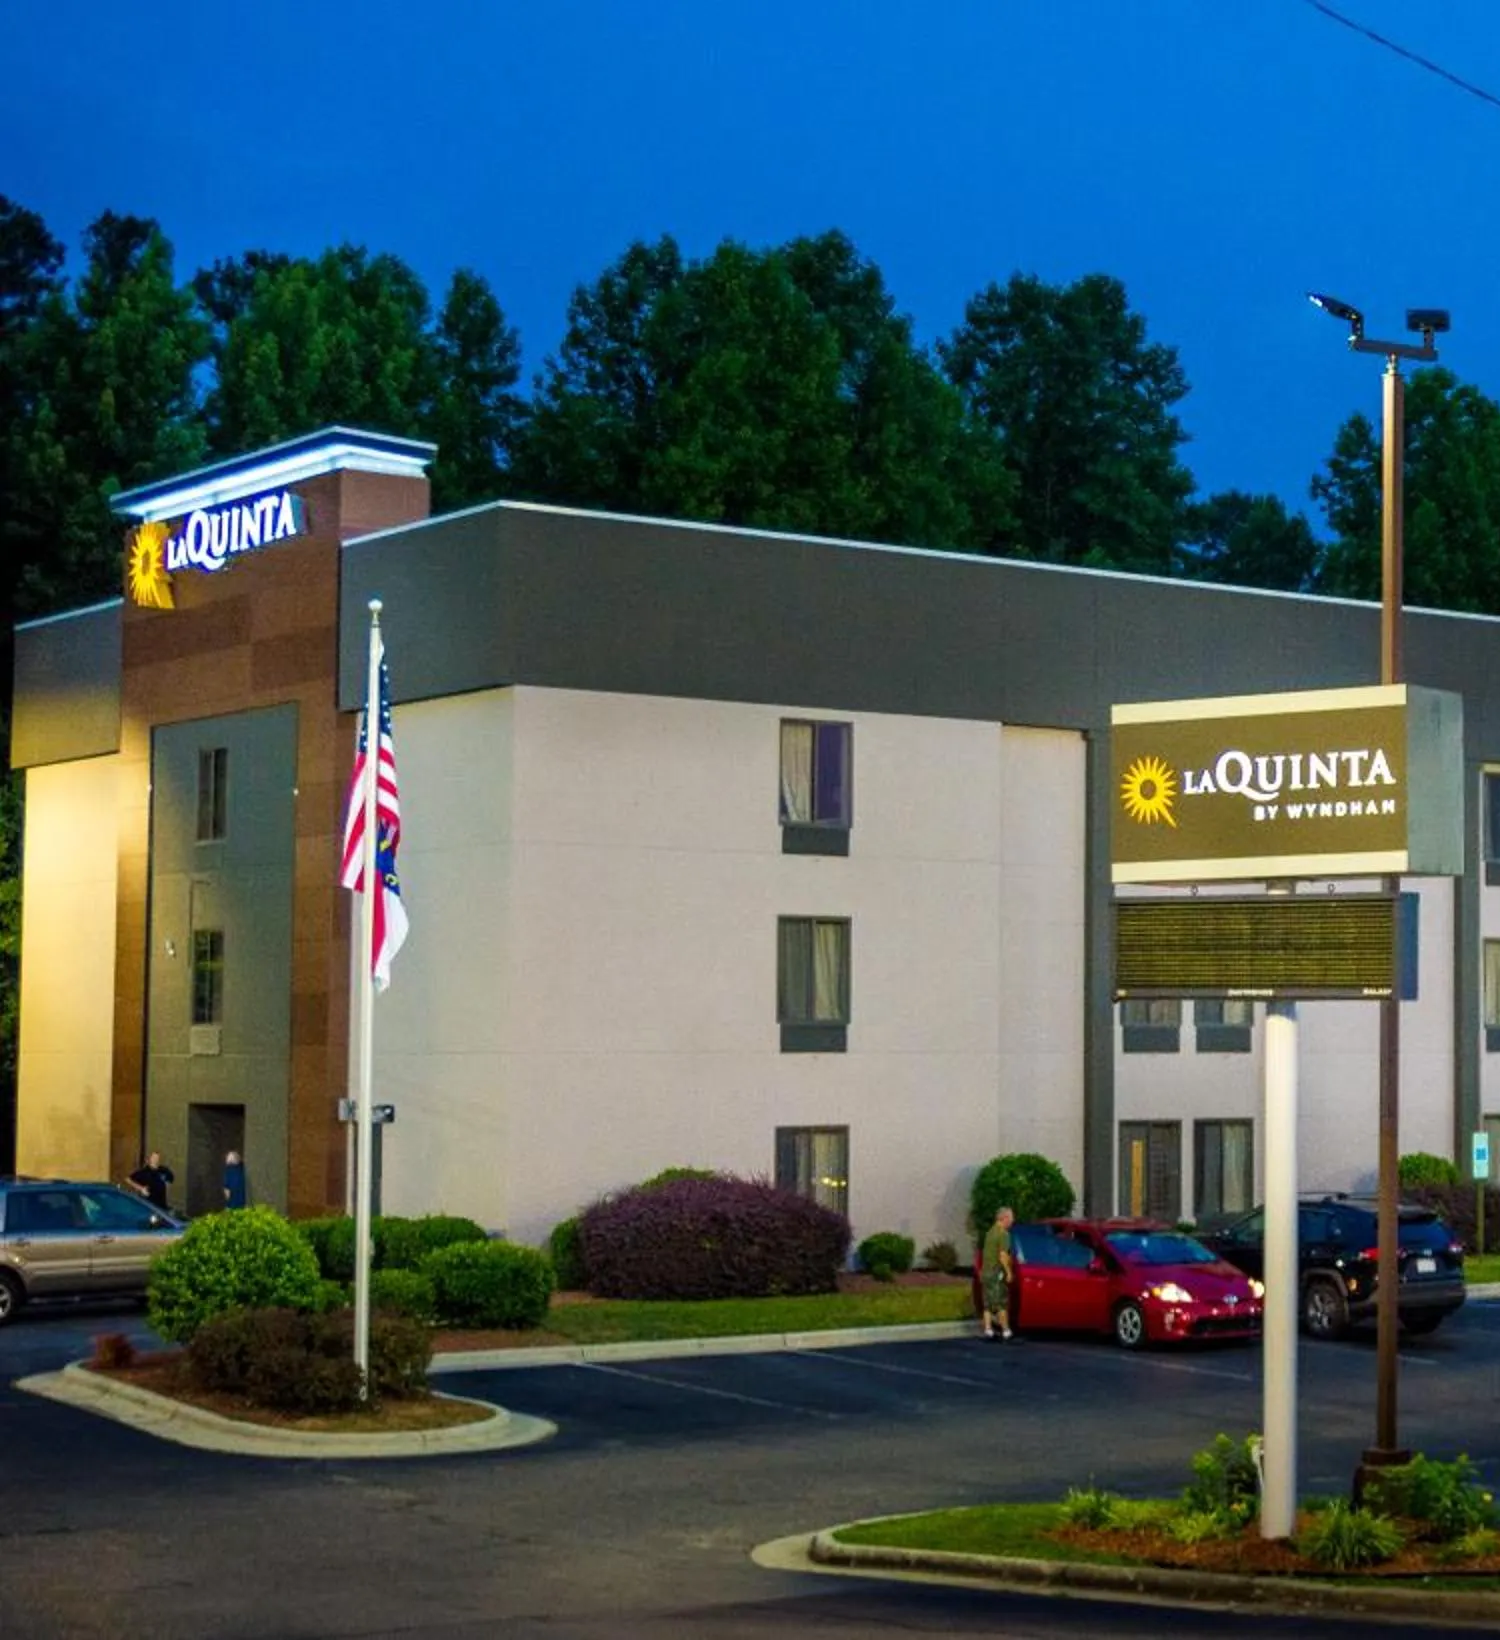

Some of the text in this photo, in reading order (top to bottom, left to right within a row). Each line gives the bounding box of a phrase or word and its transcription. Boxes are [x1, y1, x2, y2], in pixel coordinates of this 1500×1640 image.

[1215, 749, 1397, 801] QUINTA
[1253, 799, 1396, 821] BY WYNDHAM
